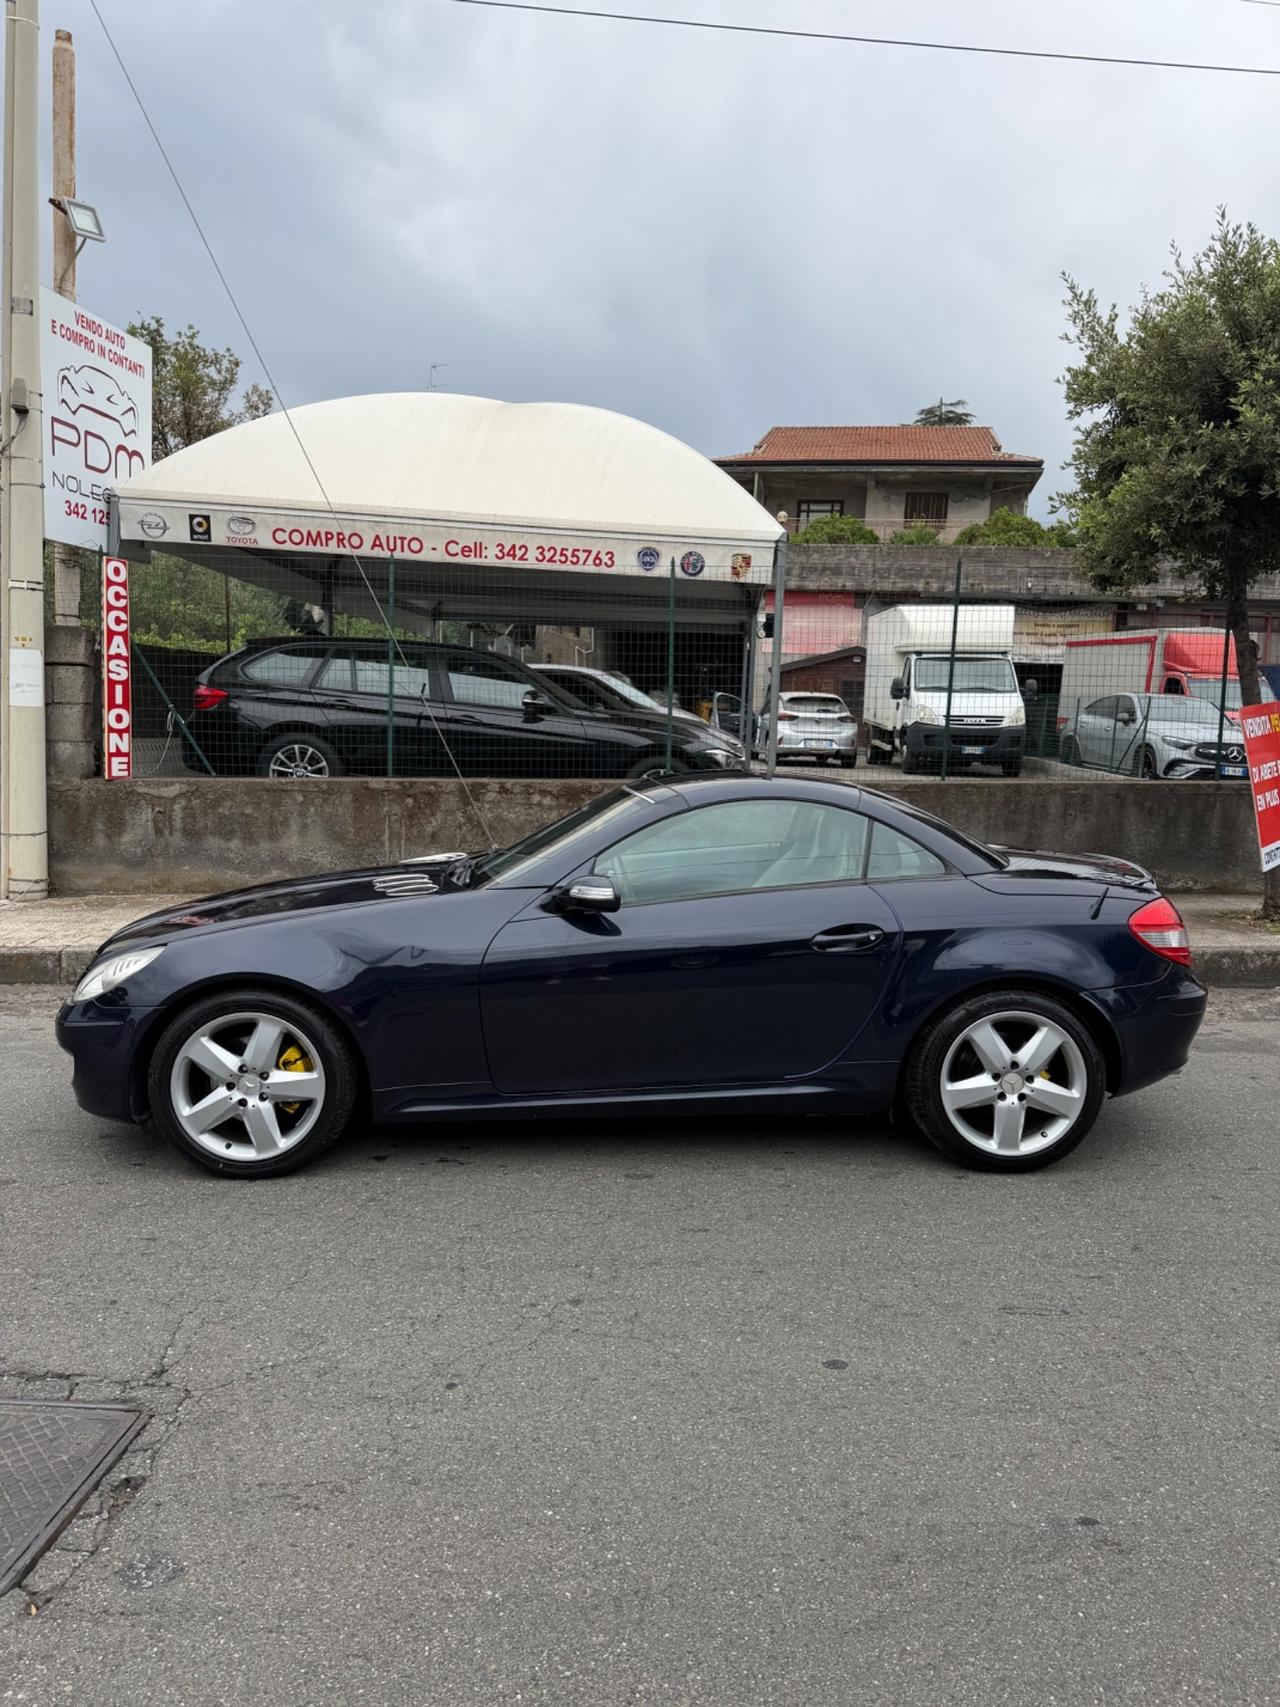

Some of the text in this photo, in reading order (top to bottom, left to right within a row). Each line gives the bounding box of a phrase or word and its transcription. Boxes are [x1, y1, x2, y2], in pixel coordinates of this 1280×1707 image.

[51, 319, 145, 379] E COMPRO IN CONTANTI
[74, 310, 126, 350] VENDO AUTO
[65, 500, 88, 520] 342
[226, 536, 258, 545] TOYOTA
[272, 527, 364, 550] COMPRO
[371, 534, 424, 554] AUTO
[444, 539, 488, 559] Cell:
[495, 543, 529, 562] 342
[535, 545, 615, 568] 3255763
[107, 560, 130, 777] OCCASIONE
